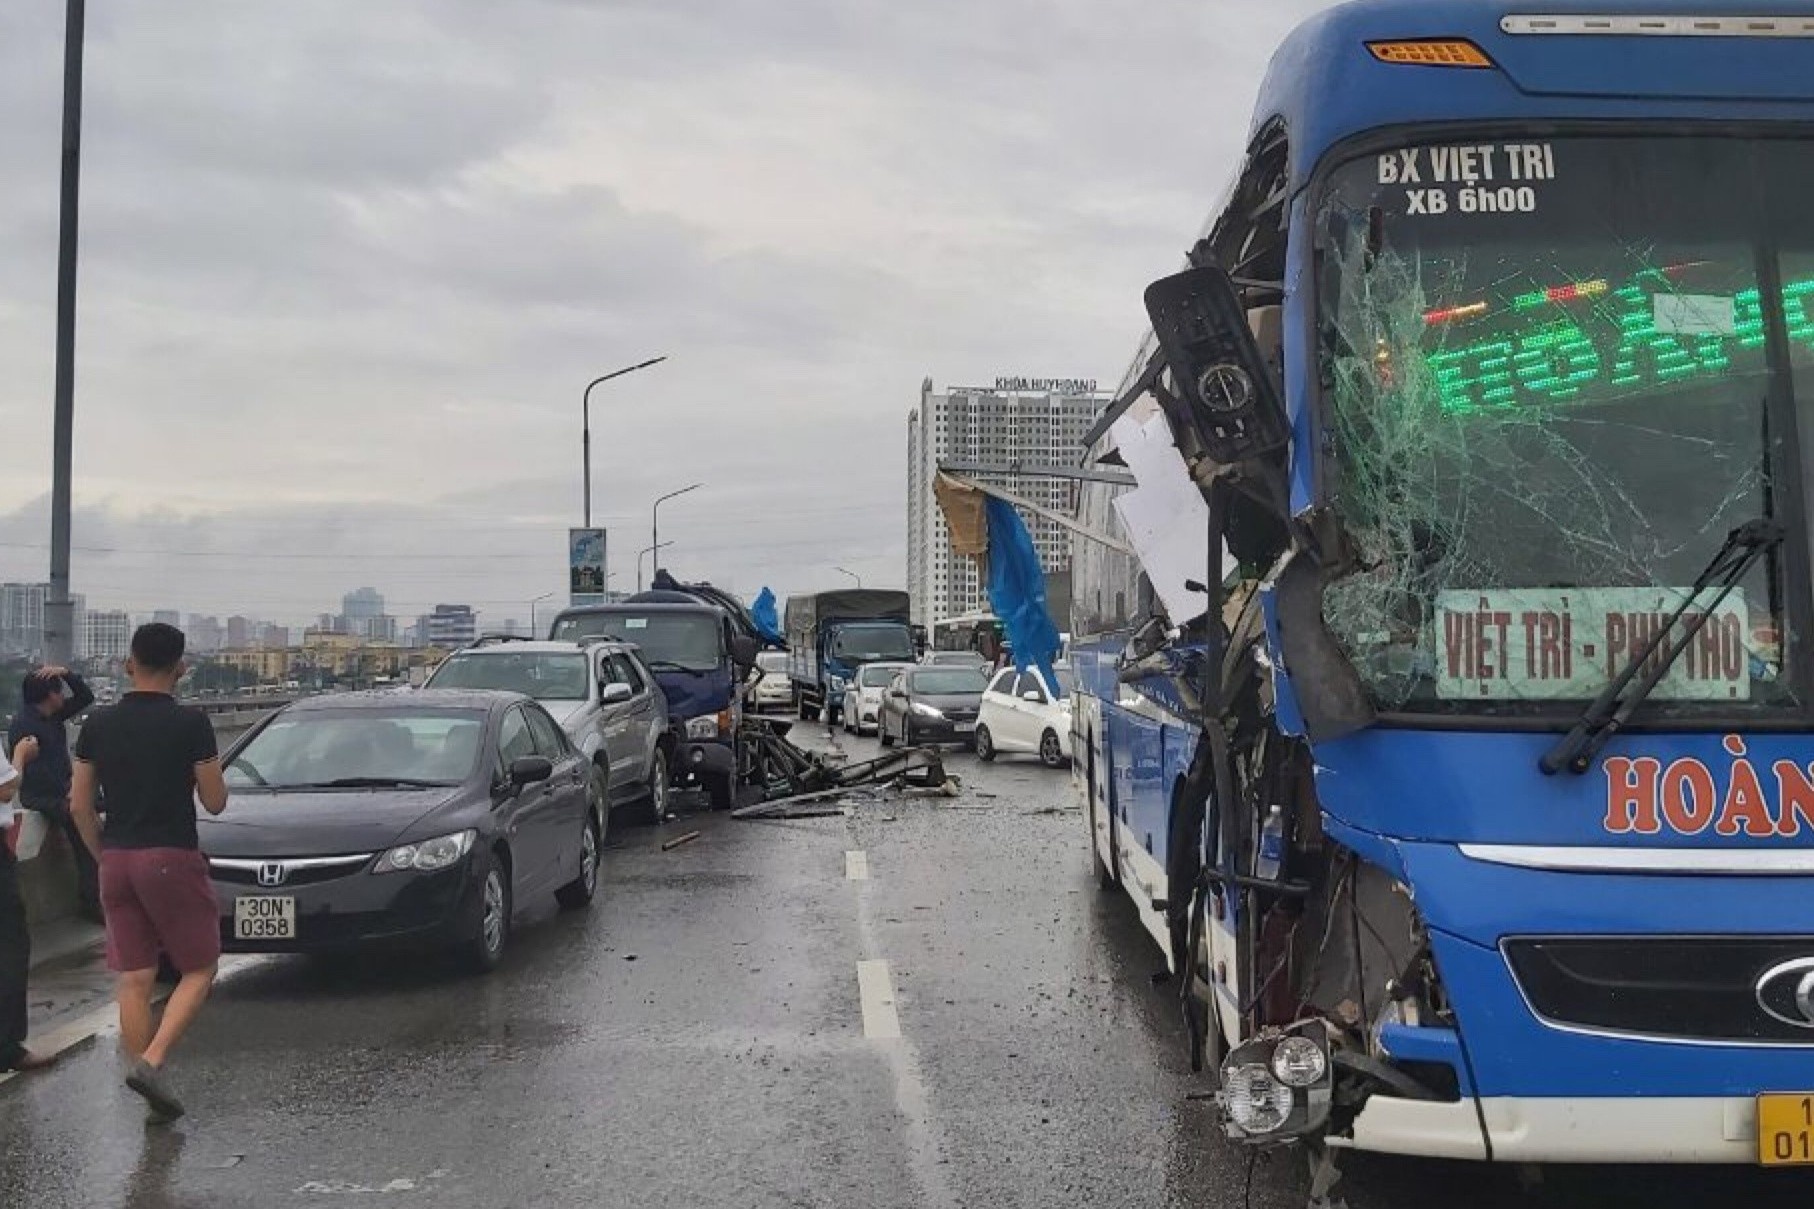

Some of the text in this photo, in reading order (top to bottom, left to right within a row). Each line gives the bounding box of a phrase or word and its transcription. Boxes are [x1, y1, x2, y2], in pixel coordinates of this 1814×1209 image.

[1378, 148, 1421, 184] BX
[1405, 186, 1536, 215] XB 6h00
[1443, 596, 1513, 696] VIỆT
[1521, 596, 1572, 680] TRÌ
[1681, 611, 1742, 698] THỌ
[247, 898, 283, 917] 30N
[241, 918, 289, 936] 0358
